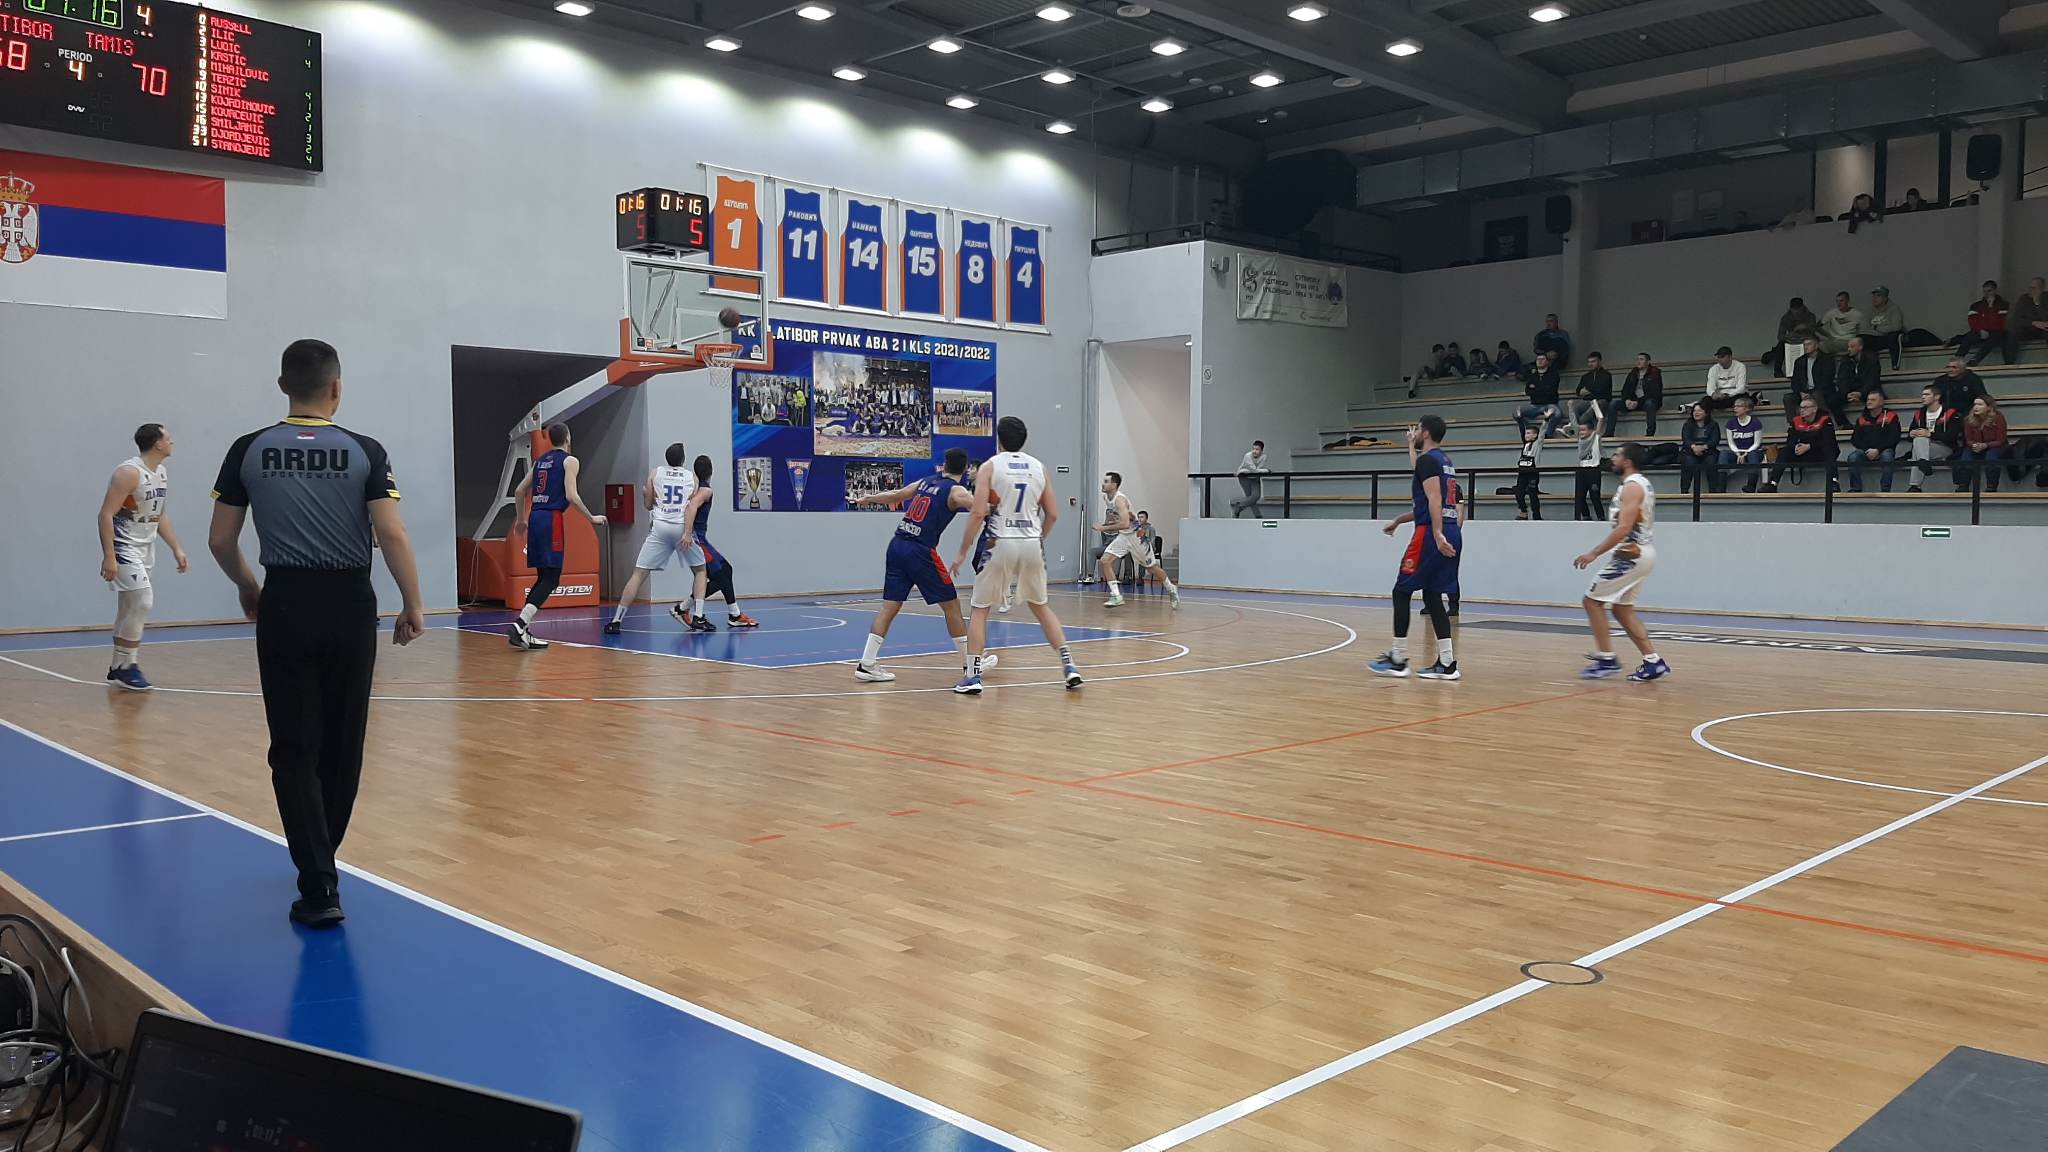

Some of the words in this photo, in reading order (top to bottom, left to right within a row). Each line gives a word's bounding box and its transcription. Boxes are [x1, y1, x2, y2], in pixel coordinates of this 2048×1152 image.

[137, 5, 150, 25] 4
[0, 38, 28, 71] 8
[58, 48, 93, 63] PERIOD
[85, 31, 134, 56] TAMIS
[69, 60, 83, 81] 4
[131, 63, 167, 96] 70
[690, 218, 704, 245] 5
[727, 218, 742, 249] 1
[788, 227, 818, 260] 11
[849, 238, 879, 271] 14
[908, 246, 936, 276] 15
[967, 255, 985, 284] 8
[1017, 261, 1032, 288] 4
[822, 330, 861, 348] PRVAK
[865, 336, 888, 351] ABA
[892, 338, 900, 352] 2
[909, 340, 931, 355] KLS
[934, 343, 991, 360] 2021/2022
[262, 447, 349, 471] ARDU
[262, 471, 349, 480] SPORTSWEAR
[537, 470, 548, 493] 3
[662, 485, 684, 505] 35
[904, 495, 931, 522] 10
[1014, 483, 1027, 513] 7
